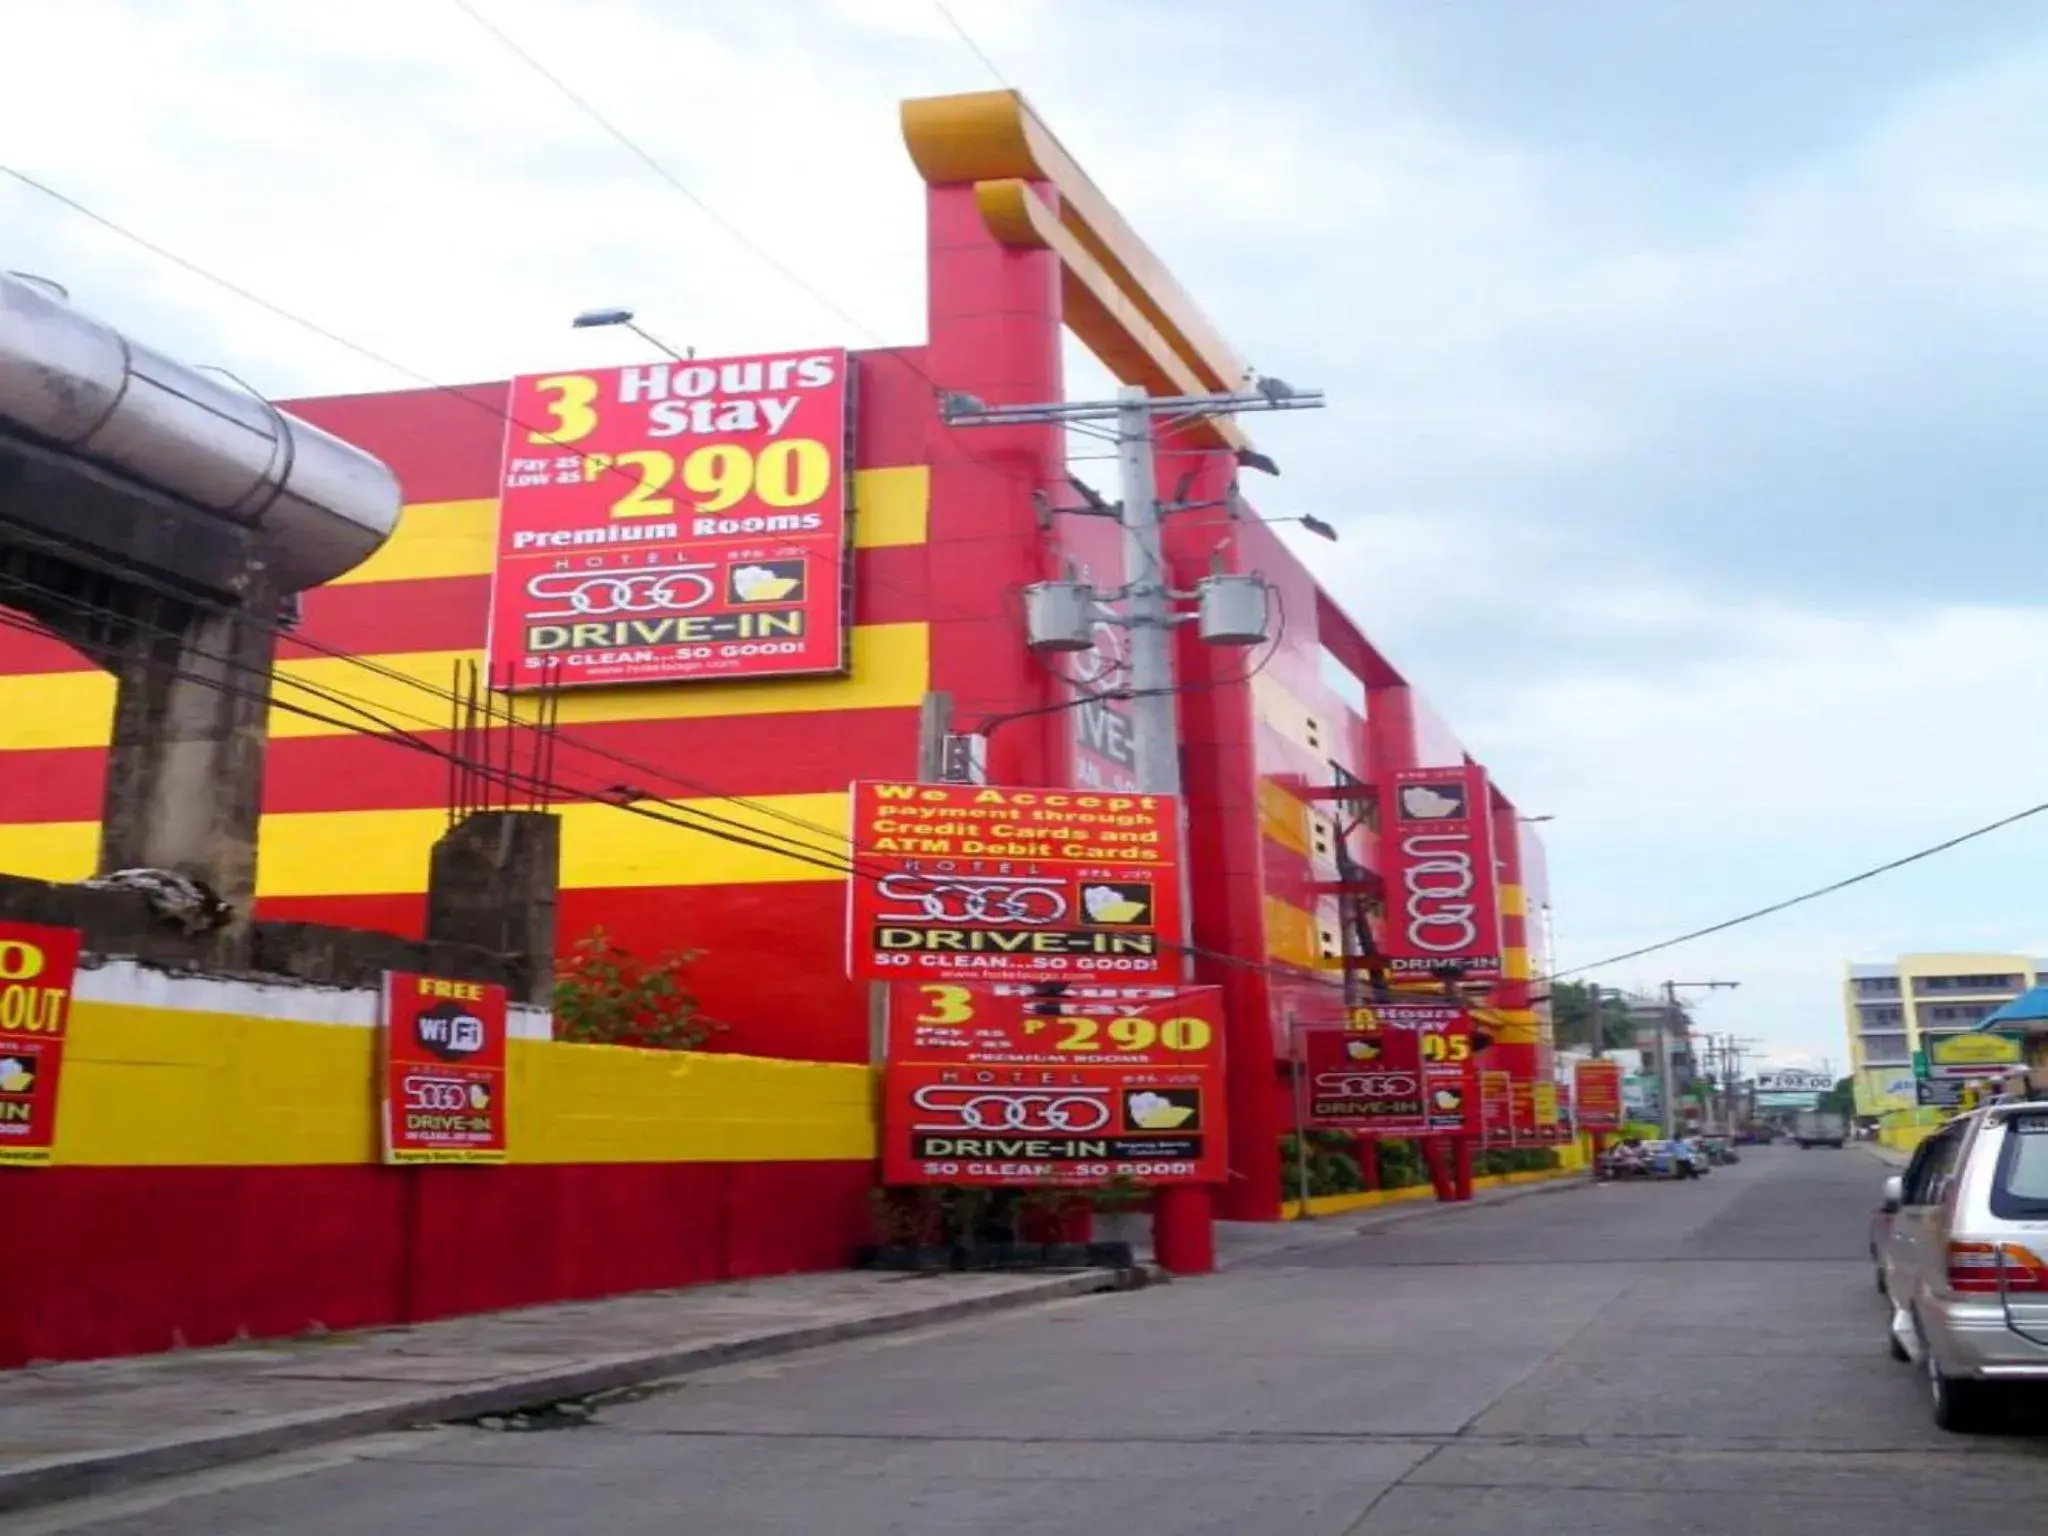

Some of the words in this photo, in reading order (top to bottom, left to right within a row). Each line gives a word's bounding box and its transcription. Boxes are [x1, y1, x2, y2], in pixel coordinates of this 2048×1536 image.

[528, 375, 598, 444] 3
[618, 355, 835, 404] Hours
[648, 395, 800, 437] Stay
[512, 522, 678, 549] Premium
[692, 513, 822, 536] Rooms
[553, 551, 689, 570] HOTEL
[525, 563, 717, 618] SOGO
[528, 611, 801, 651] DRIVE-IN
[873, 784, 948, 801] We
[974, 789, 1157, 811] Accept
[877, 804, 1020, 820] payment
[1031, 808, 1154, 826] through
[872, 819, 980, 836] Credit
[990, 824, 1089, 840] Cards
[1100, 828, 1158, 842] and
[875, 837, 950, 853] ATM
[962, 840, 1051, 856] Debit
[1061, 843, 1158, 860] Cards
[904, 860, 1040, 874] HOTEL
[876, 872, 1067, 924] SOGO
[880, 928, 1152, 953] DRIVE-IN
[874, 953, 911, 966] SO
[1076, 958, 1158, 971] GOOD!
[419, 978, 484, 1000] FREE
[917, 984, 974, 1025] 3
[993, 985, 1176, 998] Hurs
[943, 1071, 1082, 1083] HOTEL
[1315, 1072, 1416, 1098] SOGO
[913, 1085, 1110, 1132] SOGO
[925, 1138, 1106, 1158] DRIVE-IN
[924, 1162, 961, 1175] SO
